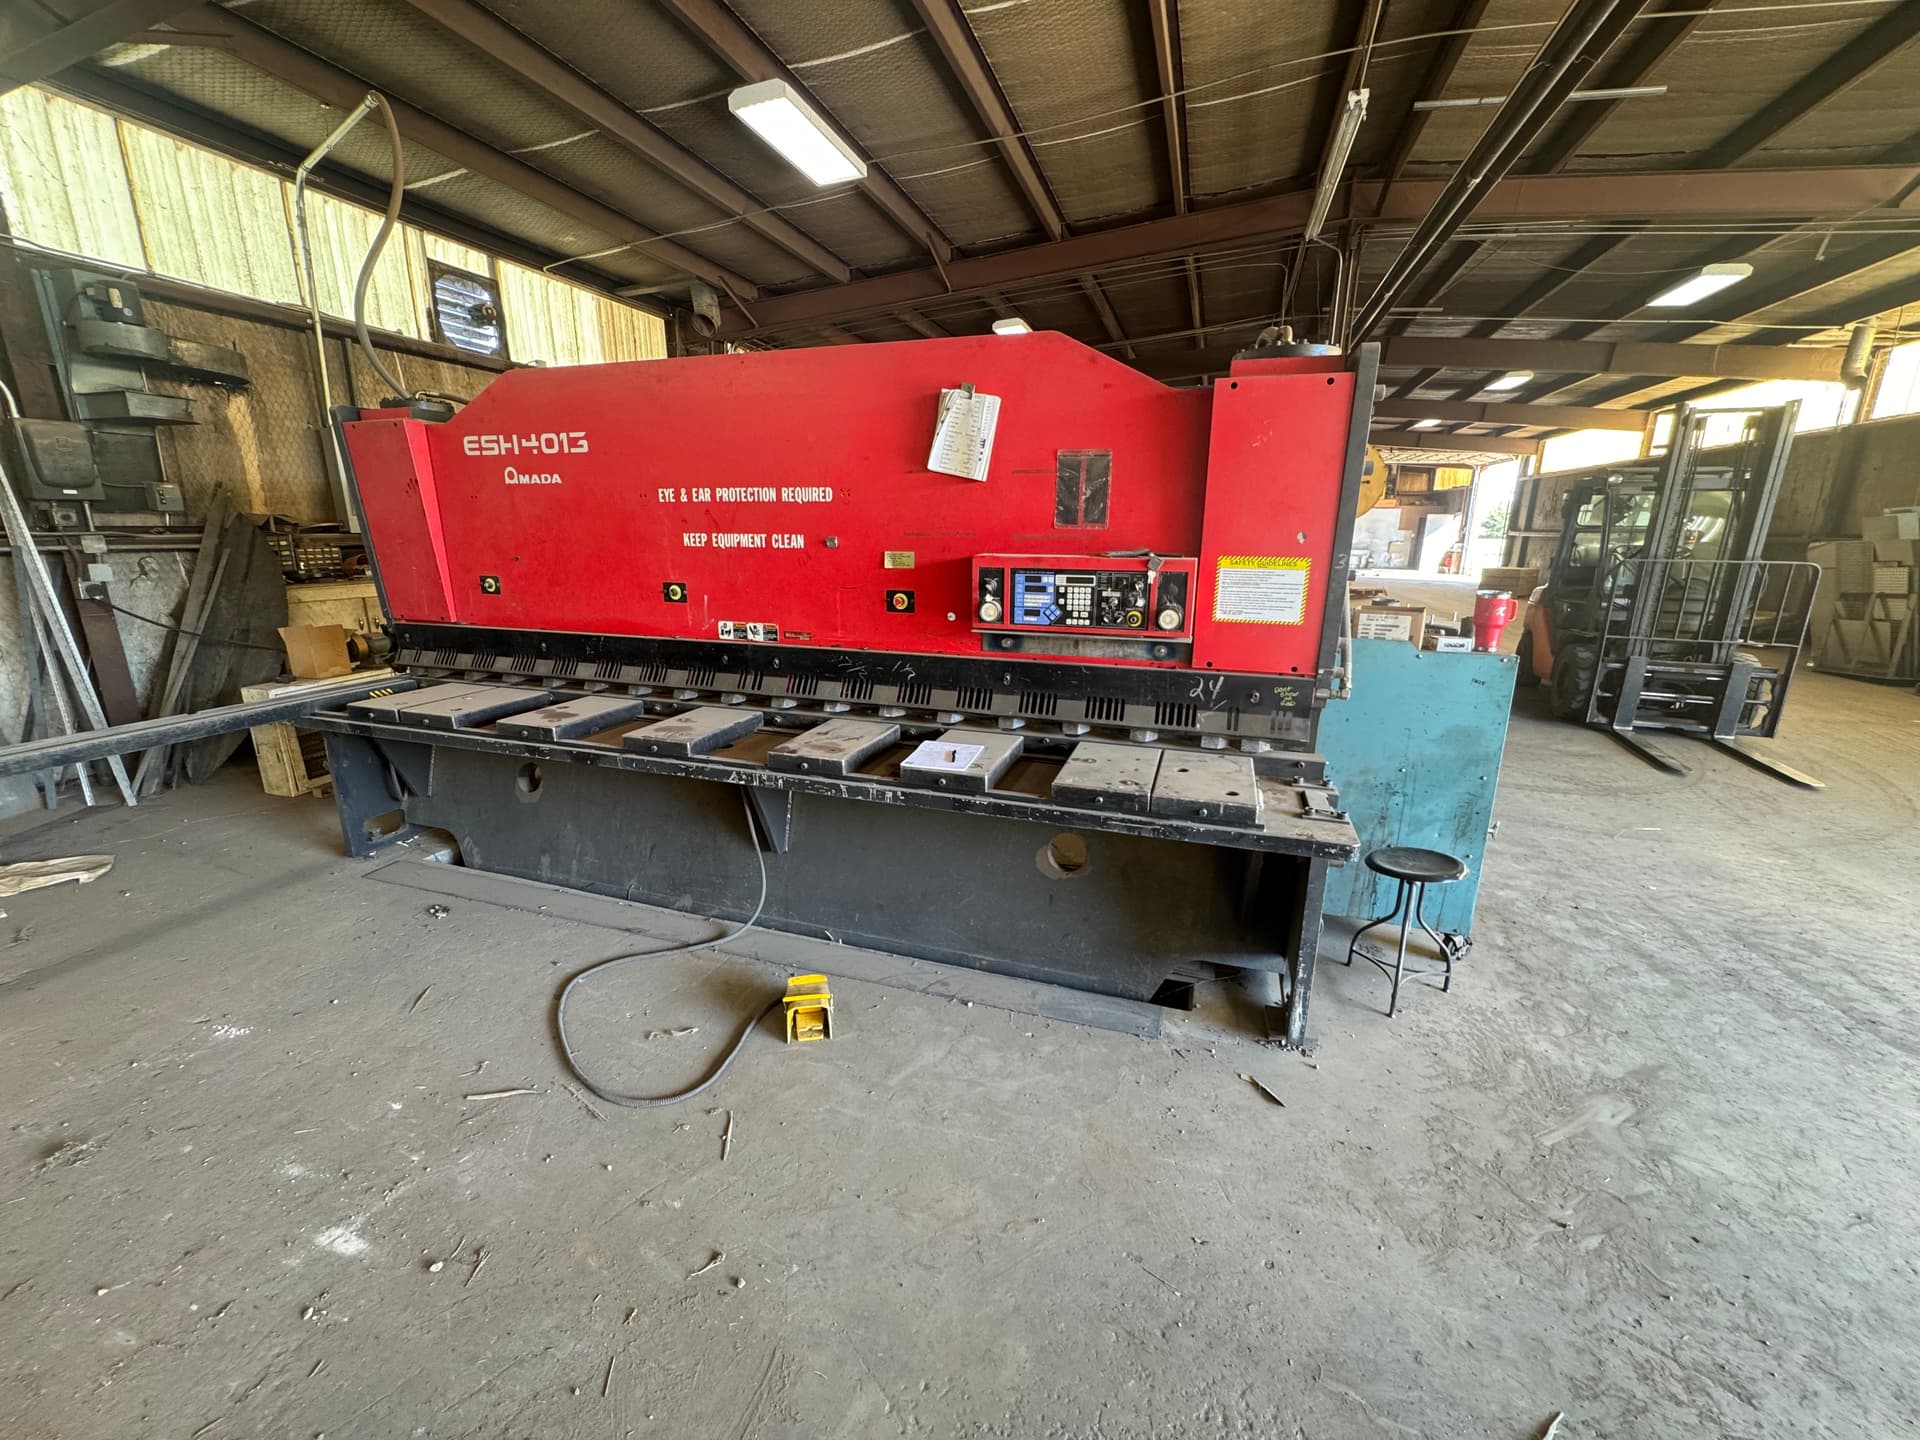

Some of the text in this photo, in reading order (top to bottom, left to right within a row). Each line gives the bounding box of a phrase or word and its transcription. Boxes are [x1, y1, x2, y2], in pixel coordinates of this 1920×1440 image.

[658, 487, 833, 504] EYE & EAR PROTECTION REQUIRED
[683, 533, 804, 549] KEEP EQUIPMENT CLEAN
[1257, 560, 1297, 568] GUIDELINES
[1189, 676, 1225, 702] 24
